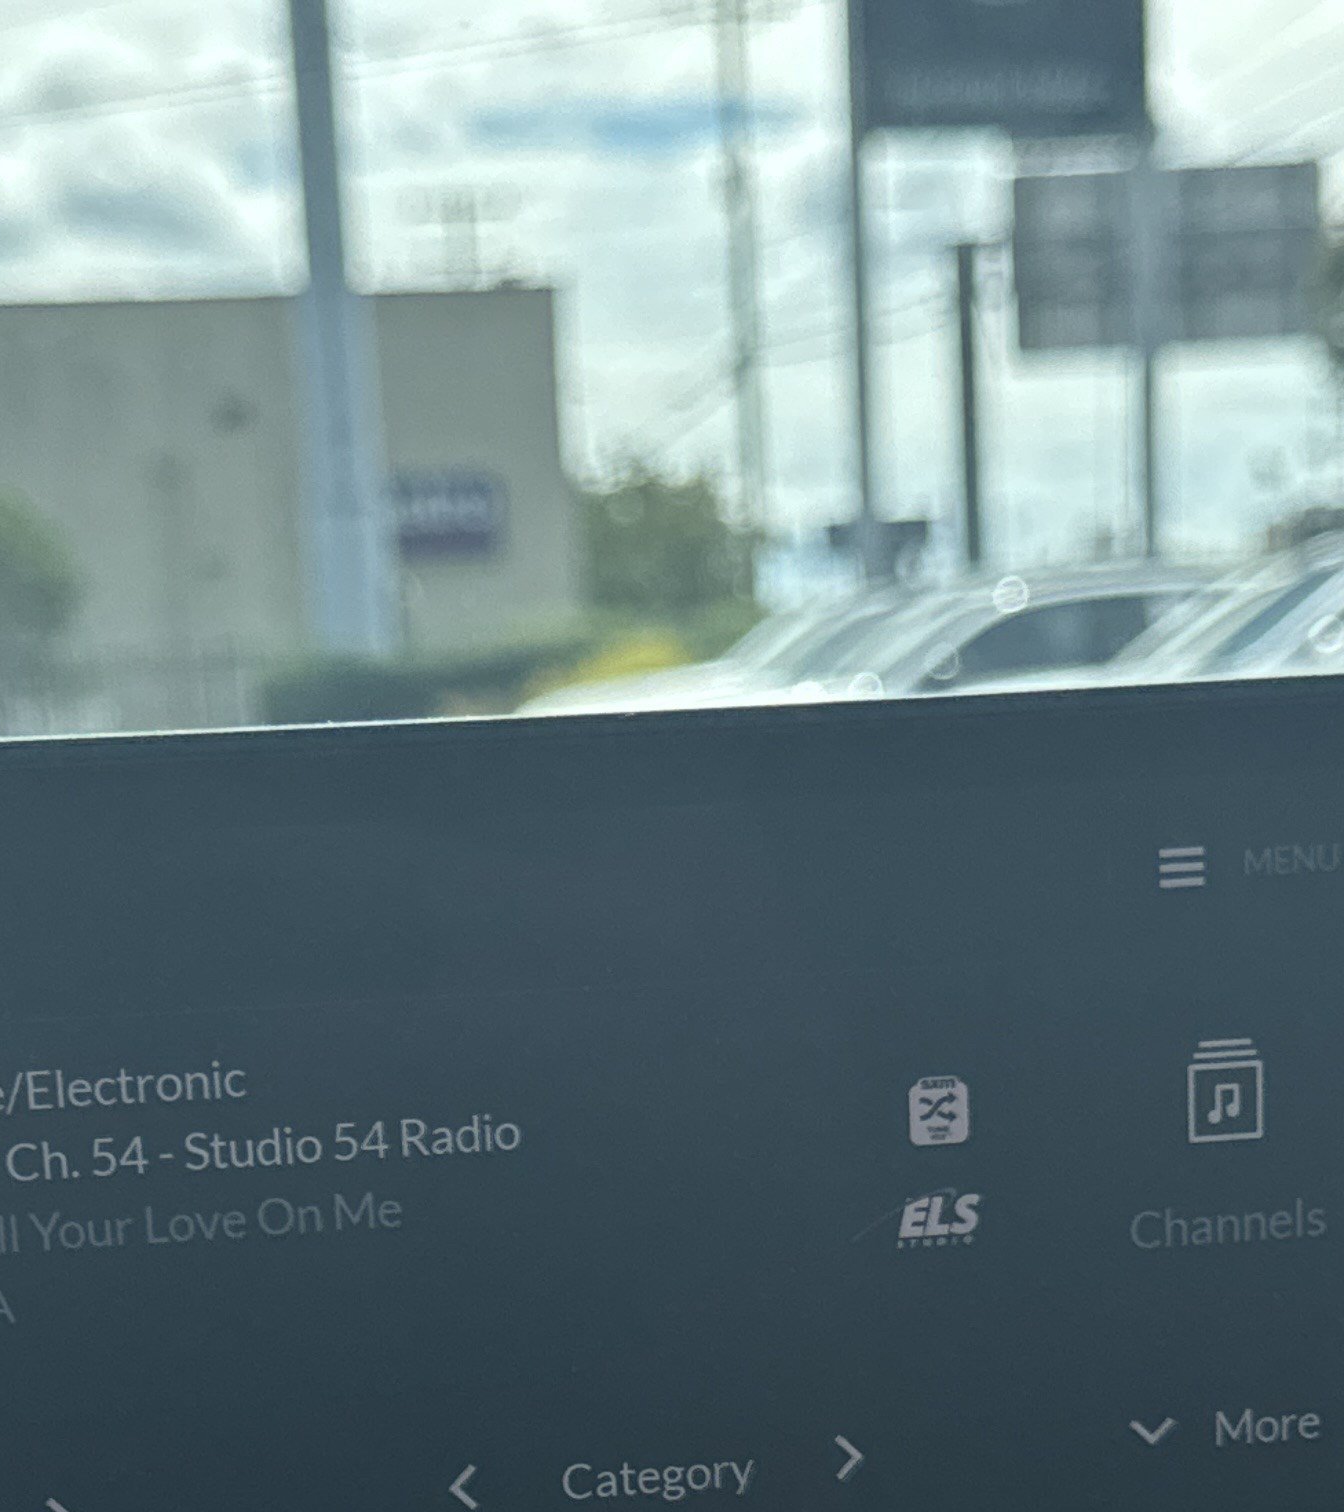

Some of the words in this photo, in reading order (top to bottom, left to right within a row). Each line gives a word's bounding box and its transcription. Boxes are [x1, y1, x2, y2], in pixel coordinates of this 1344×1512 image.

[1242, 843, 1342, 875] MENU
[5, 1142, 80, 1182] Ch.
[92, 1136, 149, 1175] 54
[184, 1124, 322, 1171] Studio
[334, 1121, 389, 1161] 54
[400, 1114, 522, 1158] Radio
[28, 1210, 132, 1251] Your
[144, 1204, 247, 1245] Love
[257, 1196, 323, 1237] On
[334, 1191, 403, 1232] Me
[898, 1192, 981, 1238] ELS
[1130, 1197, 1328, 1249] Channels
[1214, 1407, 1321, 1448] More
[562, 1459, 755, 1501] Category
